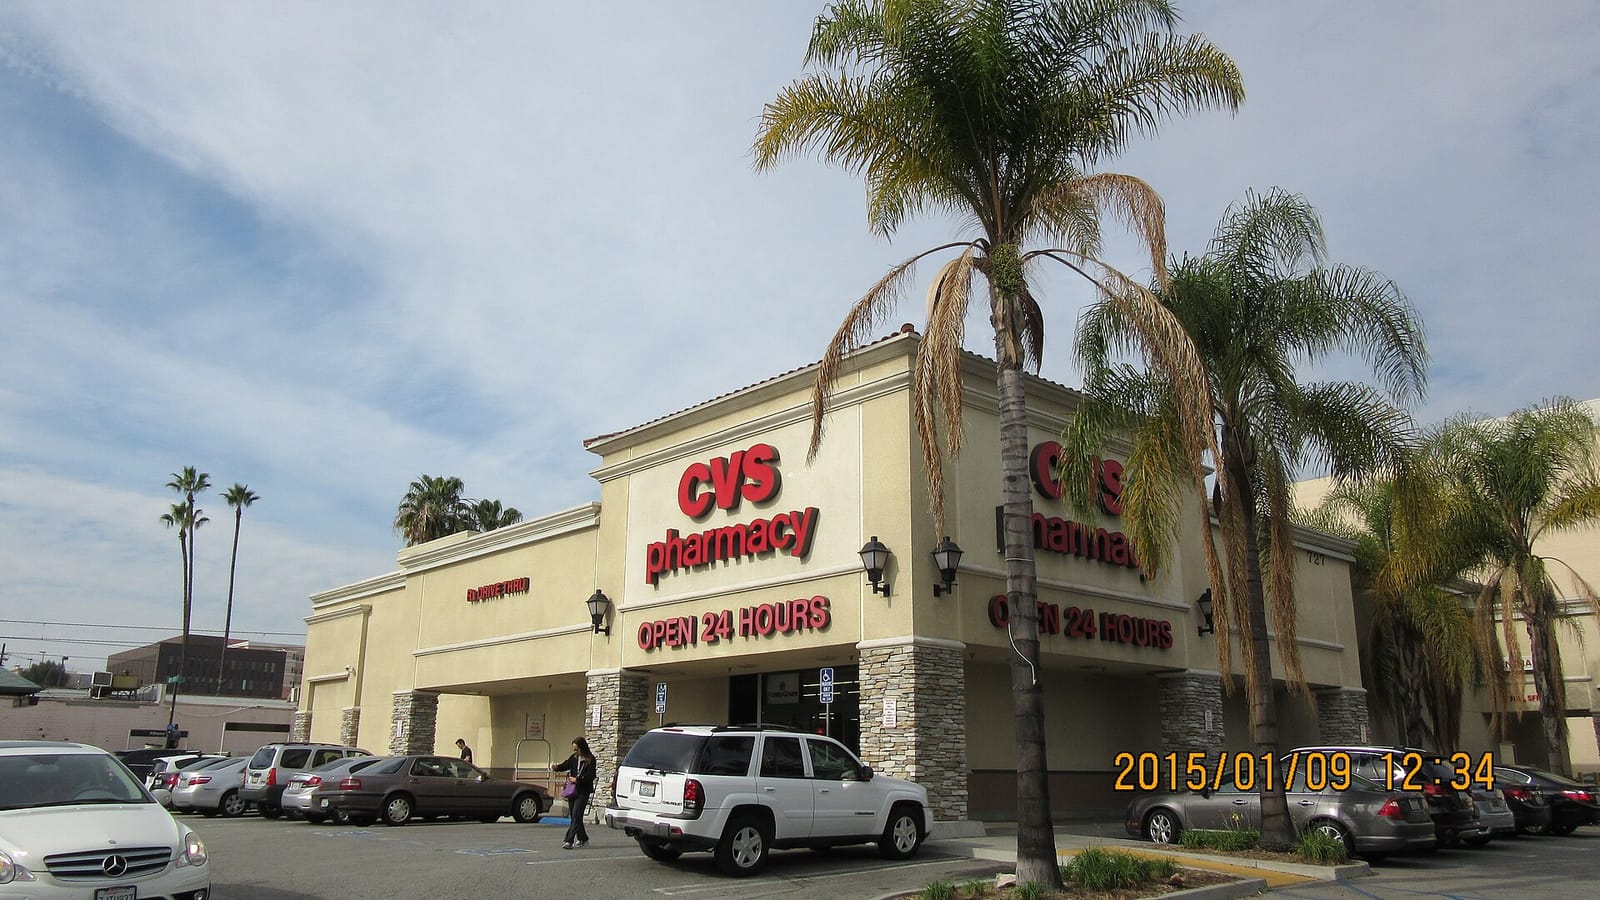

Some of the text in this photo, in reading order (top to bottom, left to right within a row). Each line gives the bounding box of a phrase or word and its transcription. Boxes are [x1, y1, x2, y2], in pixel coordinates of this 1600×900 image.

[678, 443, 780, 517] CVS
[1030, 440, 1126, 516] CS
[646, 507, 819, 585] pharmacy
[1307, 551, 1325, 566] 727
[478, 583, 504, 600] DRIVE
[638, 595, 831, 650] OPEN 24 HOURS
[989, 594, 1174, 649] OEN 24 HOURS
